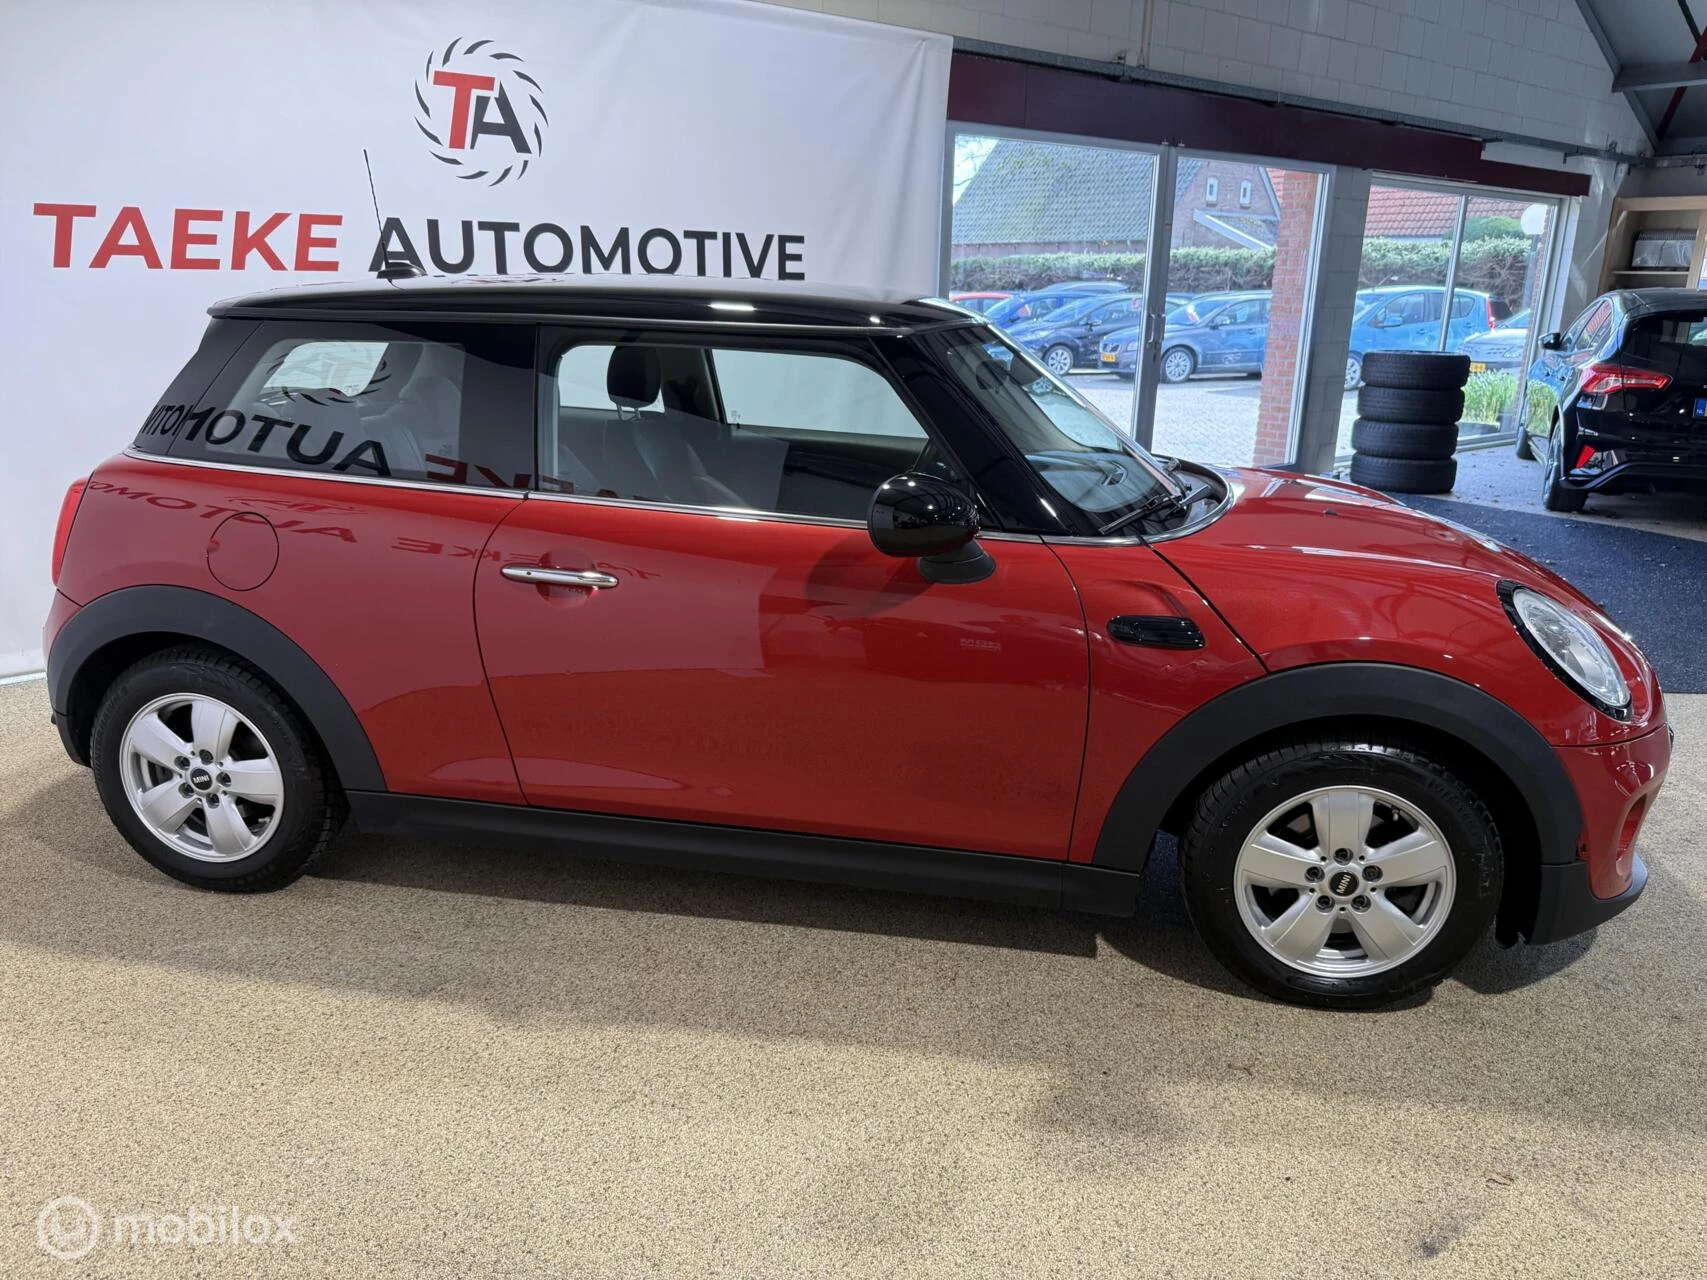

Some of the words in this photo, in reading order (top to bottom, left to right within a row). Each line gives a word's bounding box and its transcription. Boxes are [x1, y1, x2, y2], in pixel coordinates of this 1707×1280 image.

[433, 70, 532, 154] TA
[33, 202, 343, 271] TAEKE
[367, 217, 805, 281] AUTOMOTIVE
[192, 774, 210, 784] MINI
[1336, 874, 1352, 894] MINI
